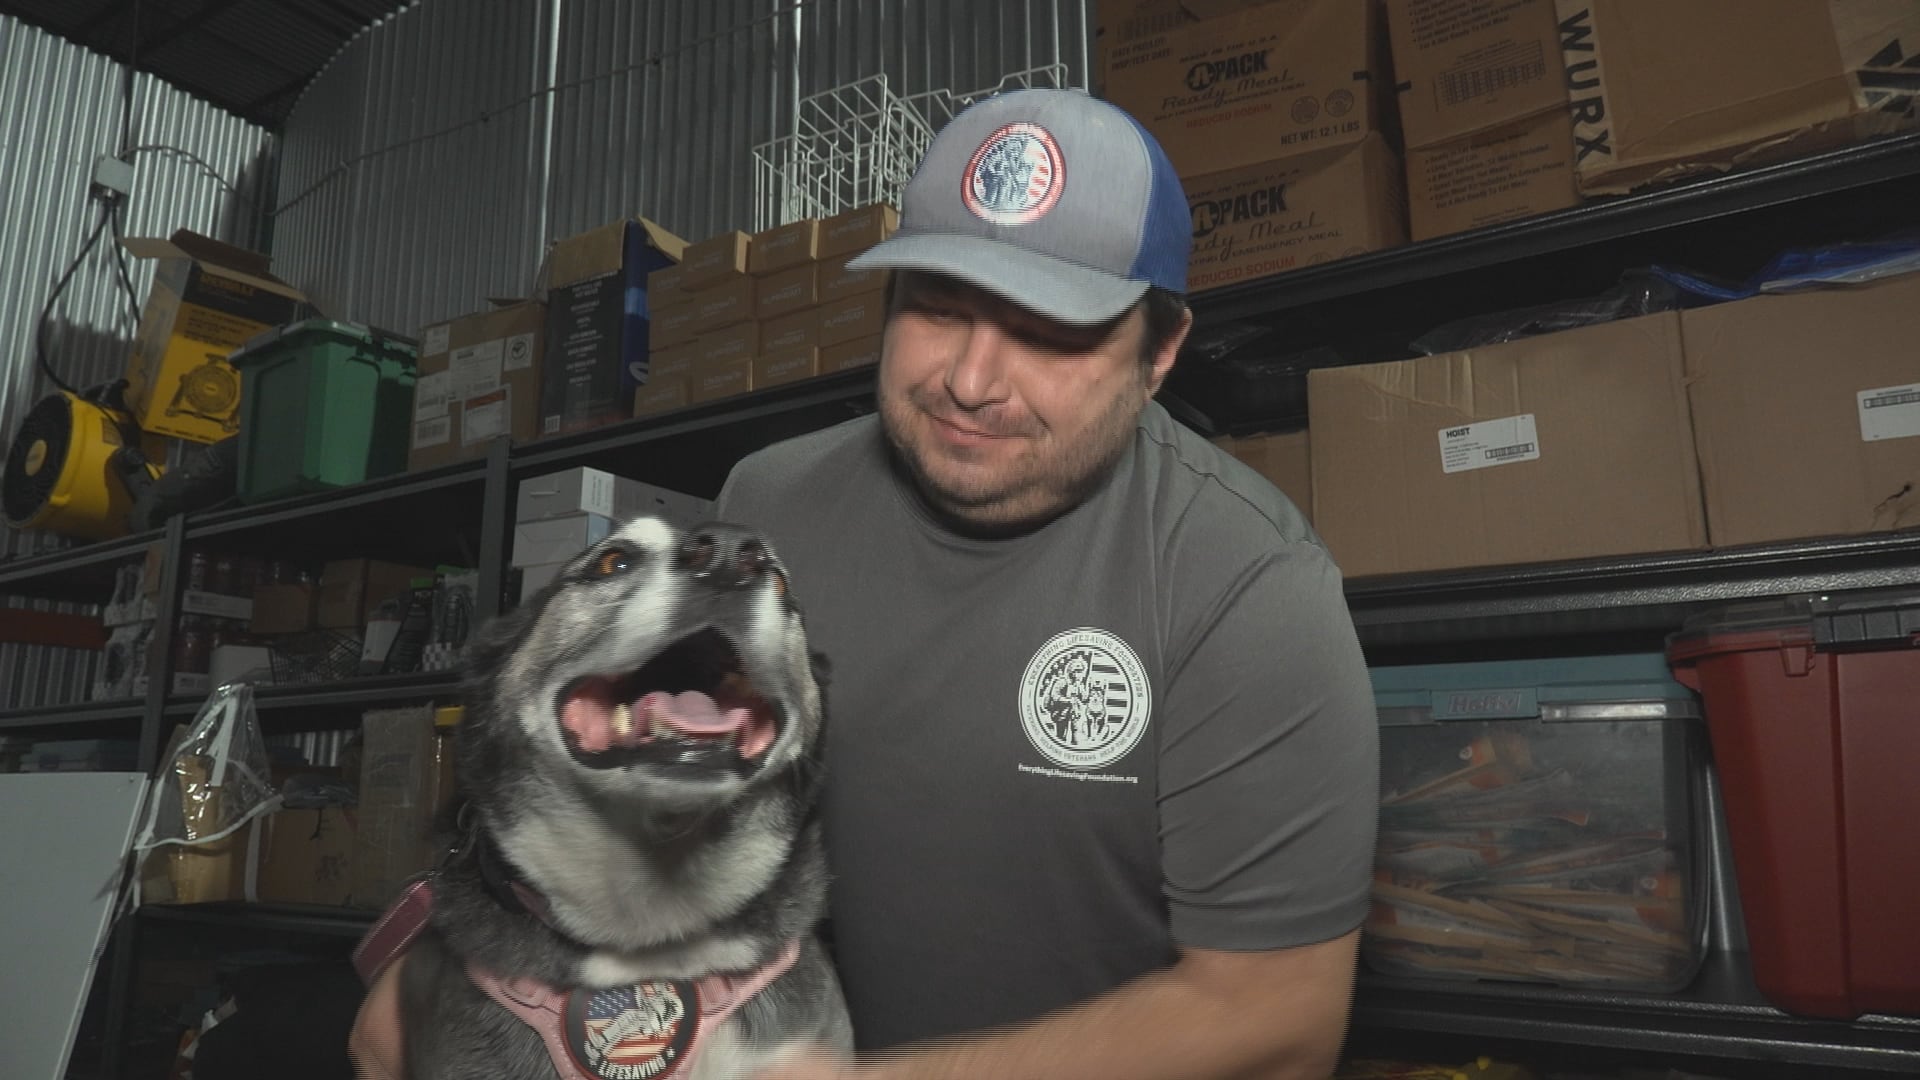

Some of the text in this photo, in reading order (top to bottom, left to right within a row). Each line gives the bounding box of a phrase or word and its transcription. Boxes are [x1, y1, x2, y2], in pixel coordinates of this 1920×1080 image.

[1161, 68, 1296, 111] Ready Meal
[1558, 7, 1612, 166] WURX
[1186, 110, 1233, 129] REDUCED
[1233, 102, 1273, 119] SODIUM
[1280, 133, 1297, 145] NET
[1319, 123, 1338, 137] 12.1
[1341, 120, 1360, 133] LBS
[1248, 211, 1326, 242] Meal
[1246, 256, 1297, 275] SODIUM
[1445, 427, 1471, 439] HOIST
[597, 1054, 667, 1080] LIFESAVING
